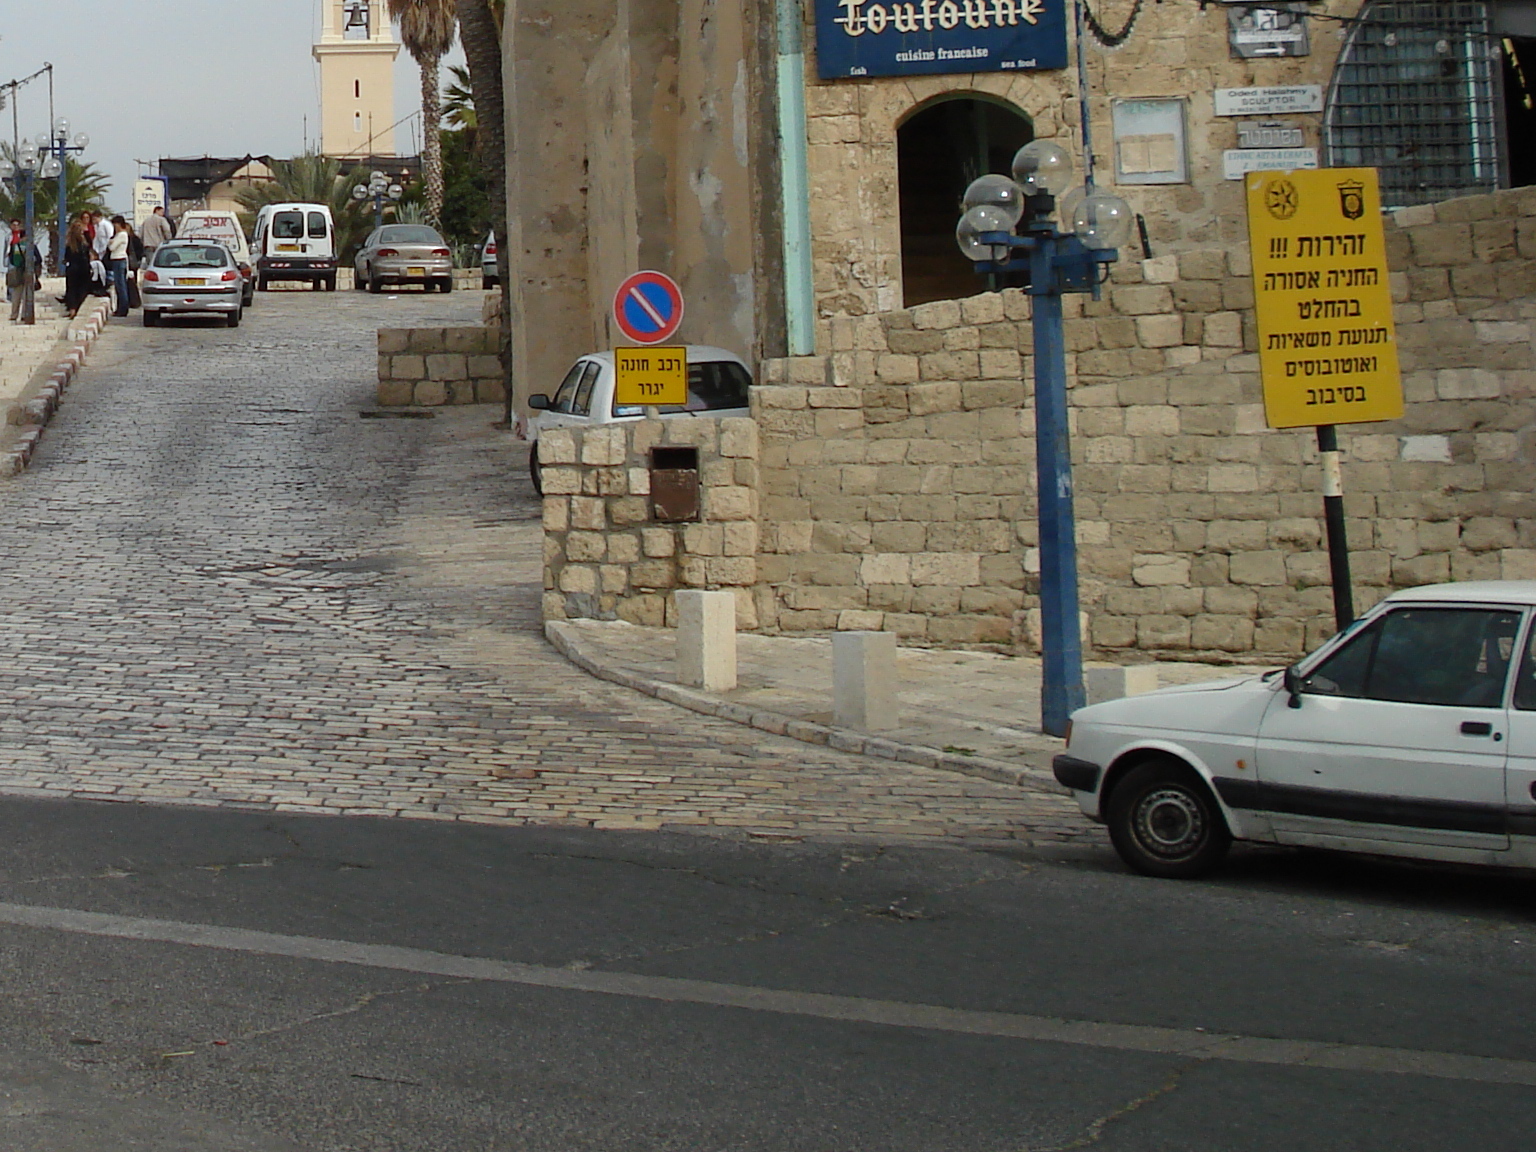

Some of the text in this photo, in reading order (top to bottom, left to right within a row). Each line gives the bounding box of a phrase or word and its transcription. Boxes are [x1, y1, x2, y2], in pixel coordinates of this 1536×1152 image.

[895, 49, 934, 62] cuisine
[1001, 58, 1036, 69] sea food
[850, 66, 867, 76] fish
[1242, 96, 1295, 105] SCULPTOR
[1296, 234, 1366, 257] זהירות
[1264, 268, 1378, 291] החניה אסורה
[1298, 298, 1361, 319] בהחלט
[1268, 327, 1387, 350] תנועת משאיות
[621, 358, 681, 371] רכב חונה
[1285, 356, 1377, 377] ואוטובוסים
[638, 383, 664, 395] יגרר
[1306, 386, 1366, 405] בסיבוב
